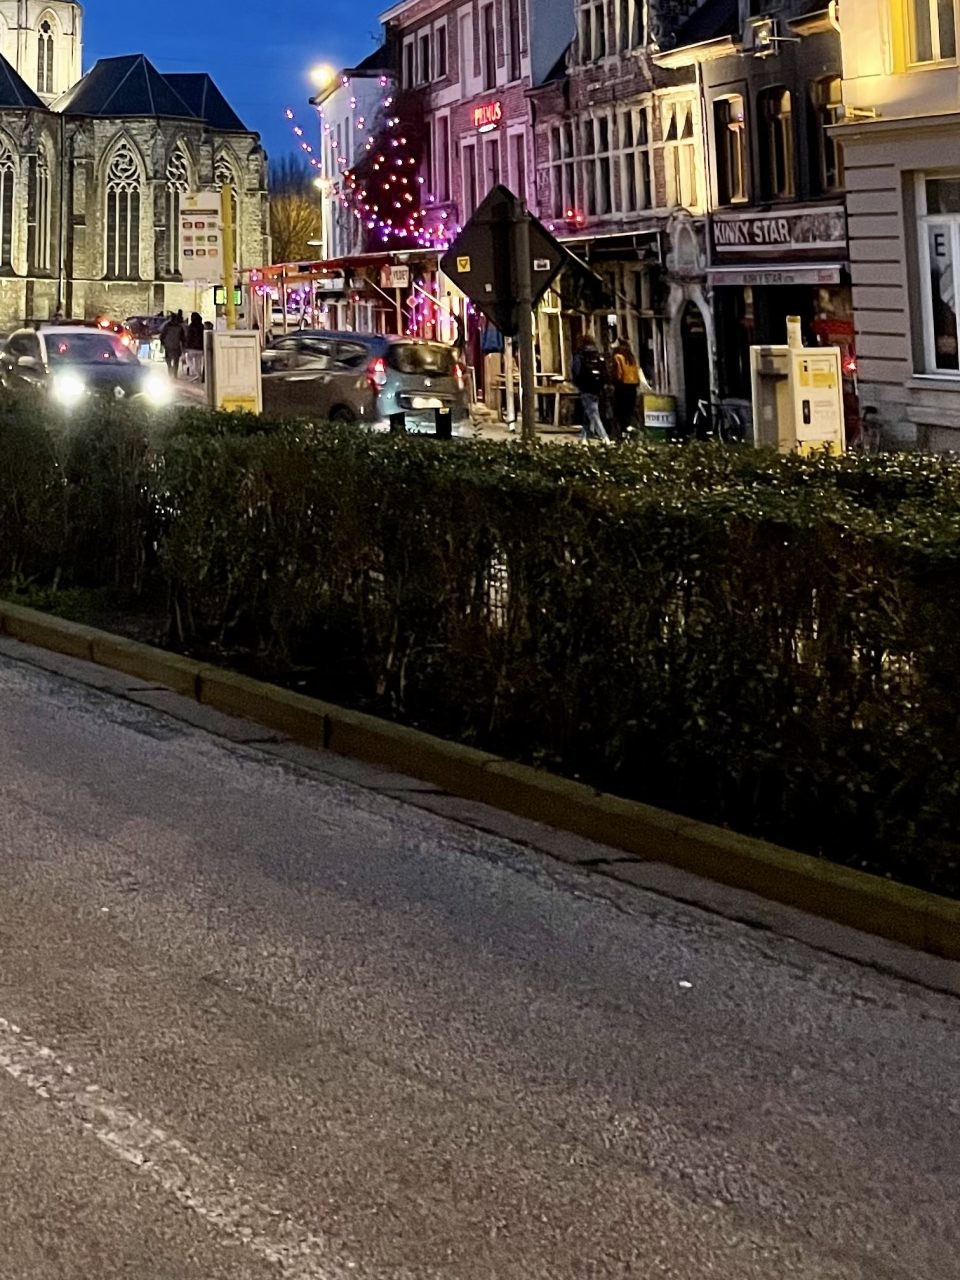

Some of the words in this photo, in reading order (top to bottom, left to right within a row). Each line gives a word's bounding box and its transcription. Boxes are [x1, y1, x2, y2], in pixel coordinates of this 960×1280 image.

[474, 101, 501, 126] PRIMUS
[713, 221, 749, 244] KINKY
[753, 219, 790, 243] STAR
[934, 233, 946, 256] E
[764, 273, 782, 284] STAR
